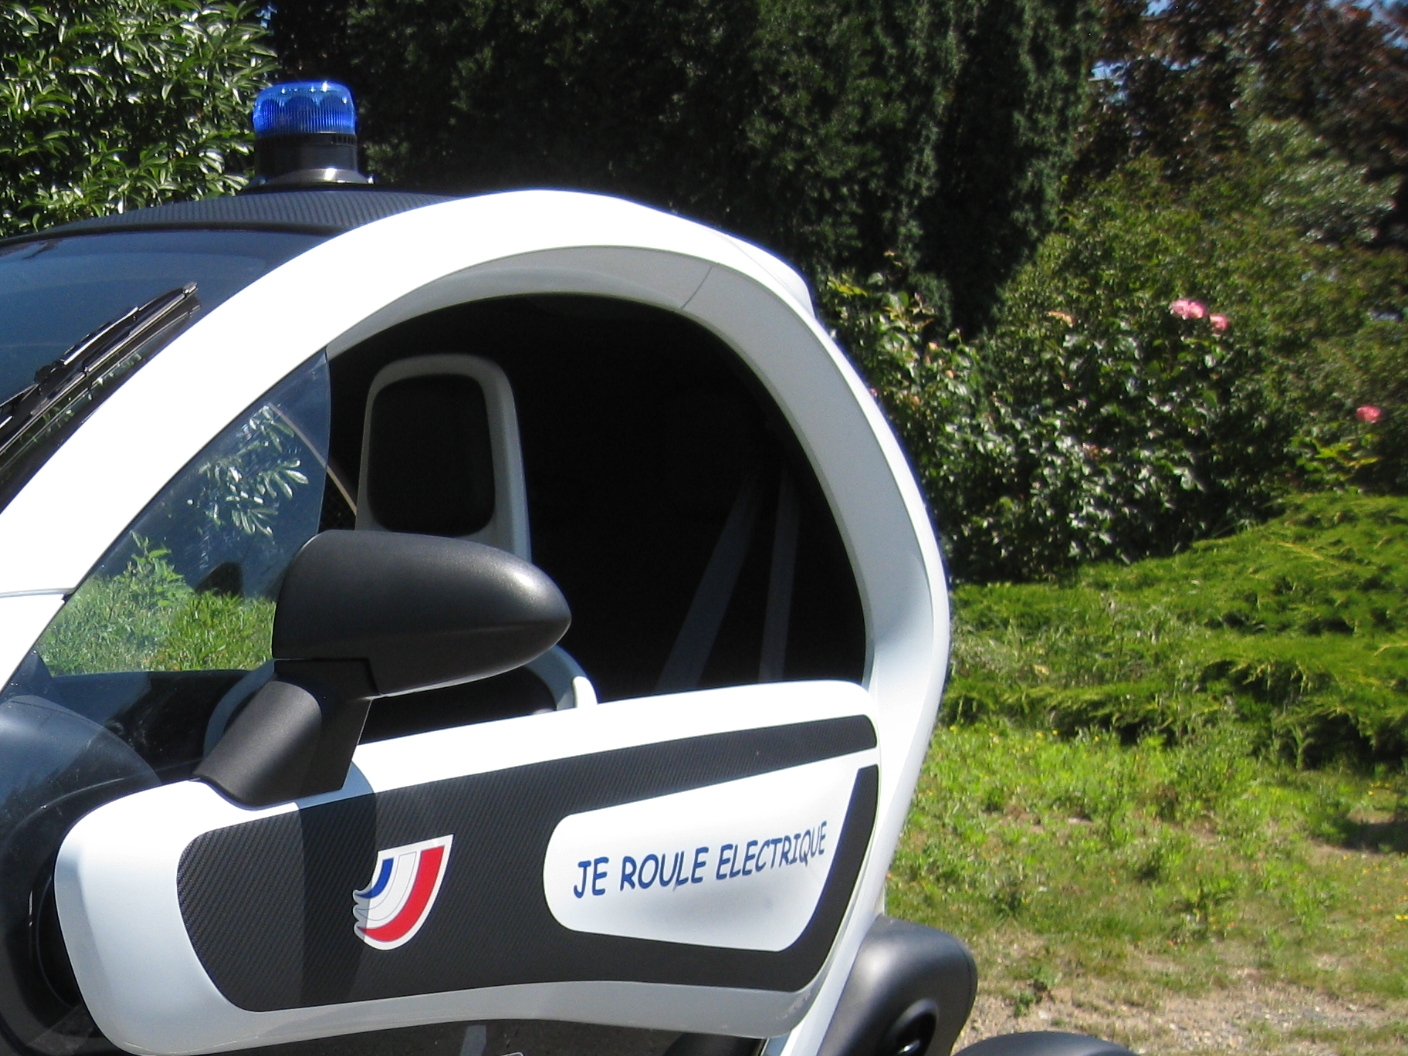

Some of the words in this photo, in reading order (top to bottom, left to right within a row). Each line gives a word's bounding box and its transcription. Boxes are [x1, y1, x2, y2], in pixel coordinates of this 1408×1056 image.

[573, 856, 610, 899] JE
[619, 846, 710, 892] ROULE
[715, 820, 828, 881] ELECTRIQUE
